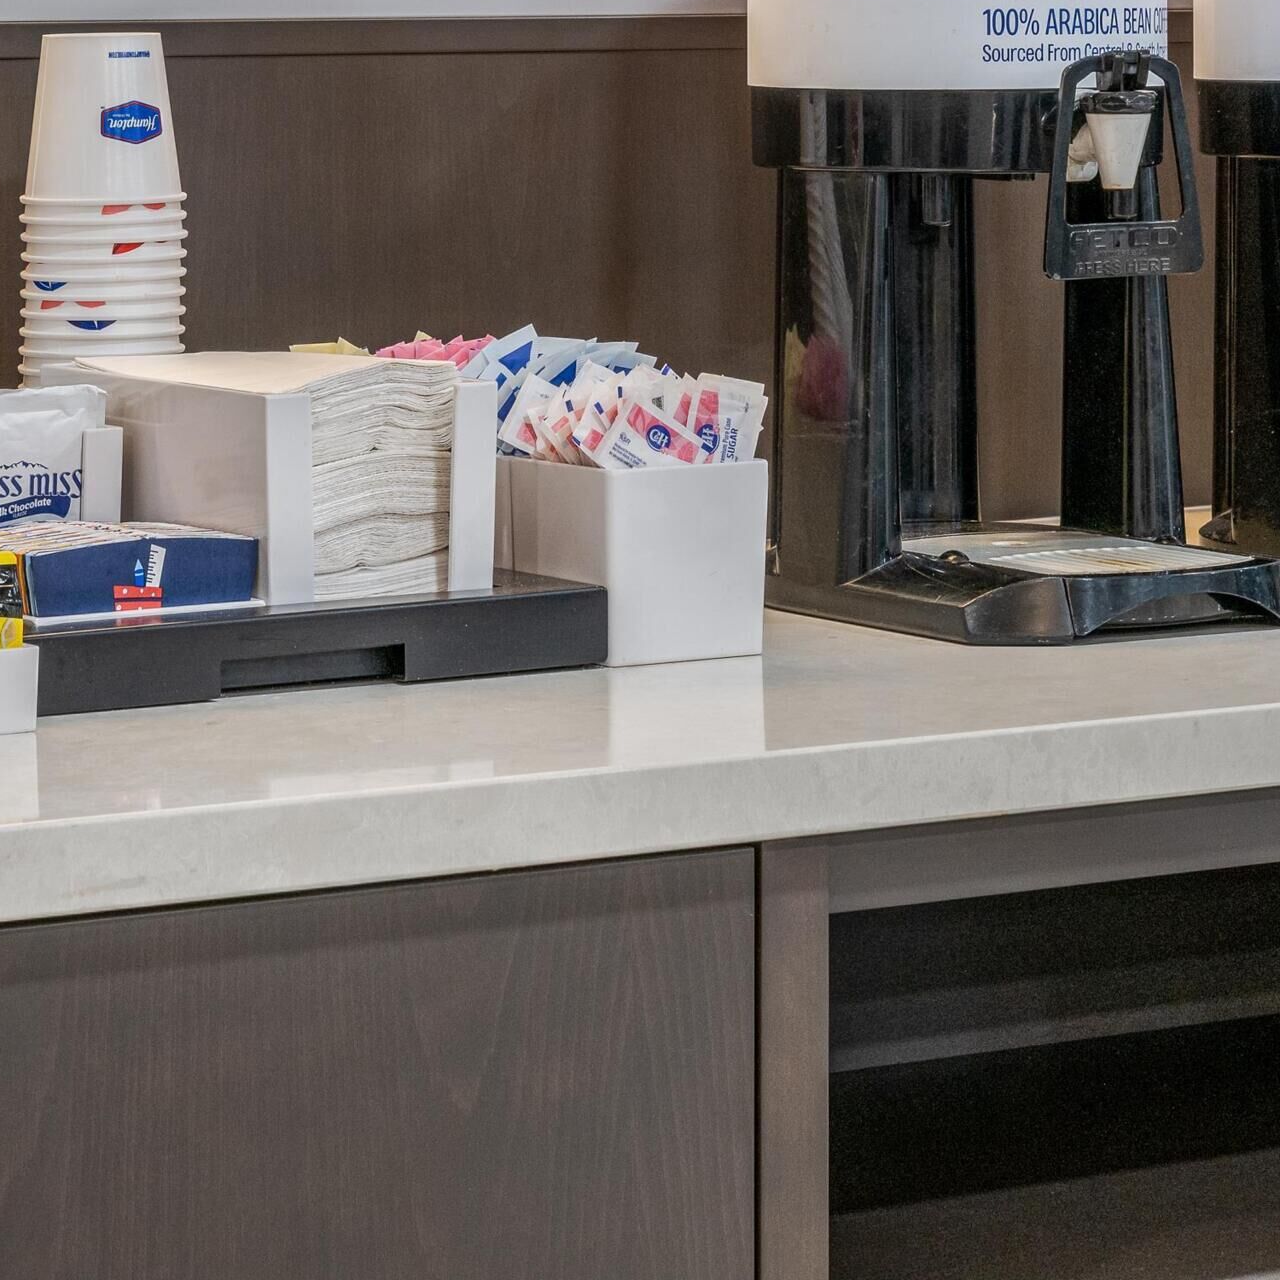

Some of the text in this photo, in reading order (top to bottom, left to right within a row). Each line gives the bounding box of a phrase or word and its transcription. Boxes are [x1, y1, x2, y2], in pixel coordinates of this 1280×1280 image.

[982, 8, 1040, 36] 100%
[1045, 7, 1119, 35] ARABICA
[1123, 7, 1151, 35] BEAN
[982, 43, 1044, 63] Sourced
[1047, 43, 1081, 62] From
[108, 114, 159, 132] Hampton
[727, 428, 739, 459] SUGAR
[8, 498, 52, 514] Chocolate
